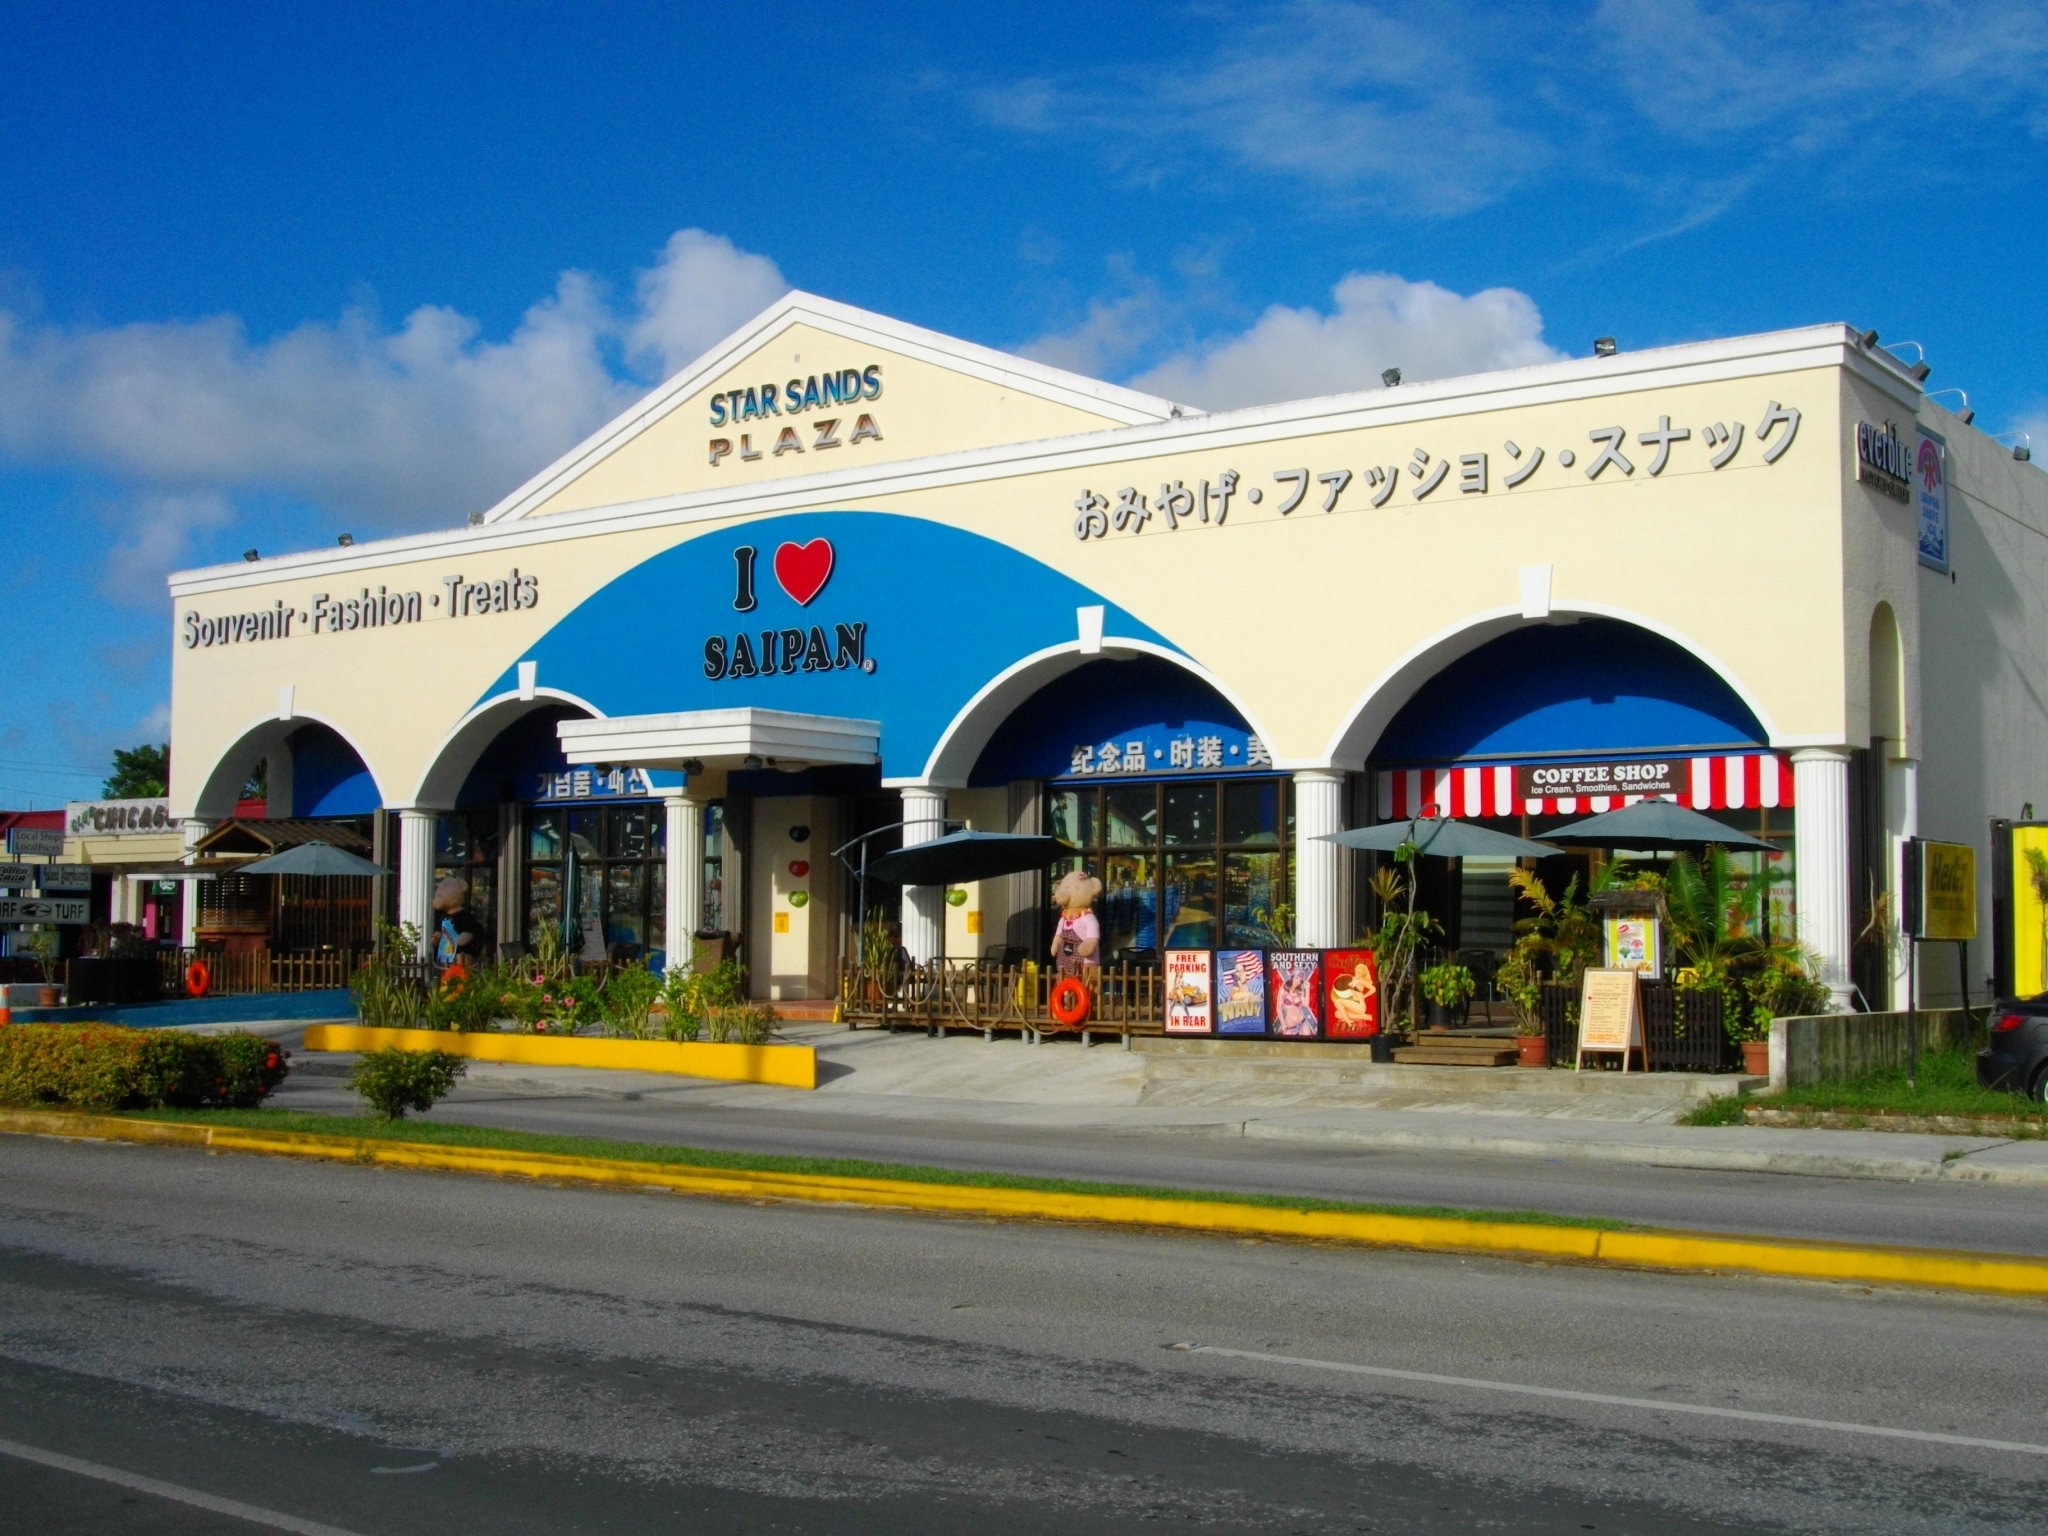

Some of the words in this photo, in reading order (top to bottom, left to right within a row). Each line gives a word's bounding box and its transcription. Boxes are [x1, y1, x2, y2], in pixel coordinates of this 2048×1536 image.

[709, 383, 782, 427] STAR
[785, 364, 883, 413] SANDS
[708, 413, 884, 467] PLAZA
[732, 545, 757, 611] I
[182, 600, 294, 649] Souvenir
[310, 586, 421, 634] Fashion
[443, 568, 538, 618] Treats
[703, 621, 866, 681] SAIPAN
[1532, 766, 1610, 785] COFFEE
[1613, 763, 1669, 781] SHOP
[1531, 785, 1543, 795] Ice
[1545, 784, 1574, 795] Cream,
[1575, 782, 1620, 794] Smoothies,
[1621, 781, 1671, 791] Sandwiches
[16, 830, 38, 840] Local
[40, 831, 60, 843] Shop
[16, 842, 38, 850] Local
[38, 843, 60, 852] Prices
[1931, 852, 1967, 892] Hertz
[0, 901, 17, 917] RF
[55, 903, 84, 919] TURF
[1176, 954, 1197, 963] FREE
[1270, 952, 1319, 962] SOUTHERN
[1273, 961, 1292, 970] AND
[1293, 961, 1317, 970] SEXY
[1169, 963, 1207, 973] PARKING
[1170, 1017, 1180, 1027] IN
[1182, 1016, 1206, 1027] REAR
[1222, 1003, 1262, 1023] NAVY
